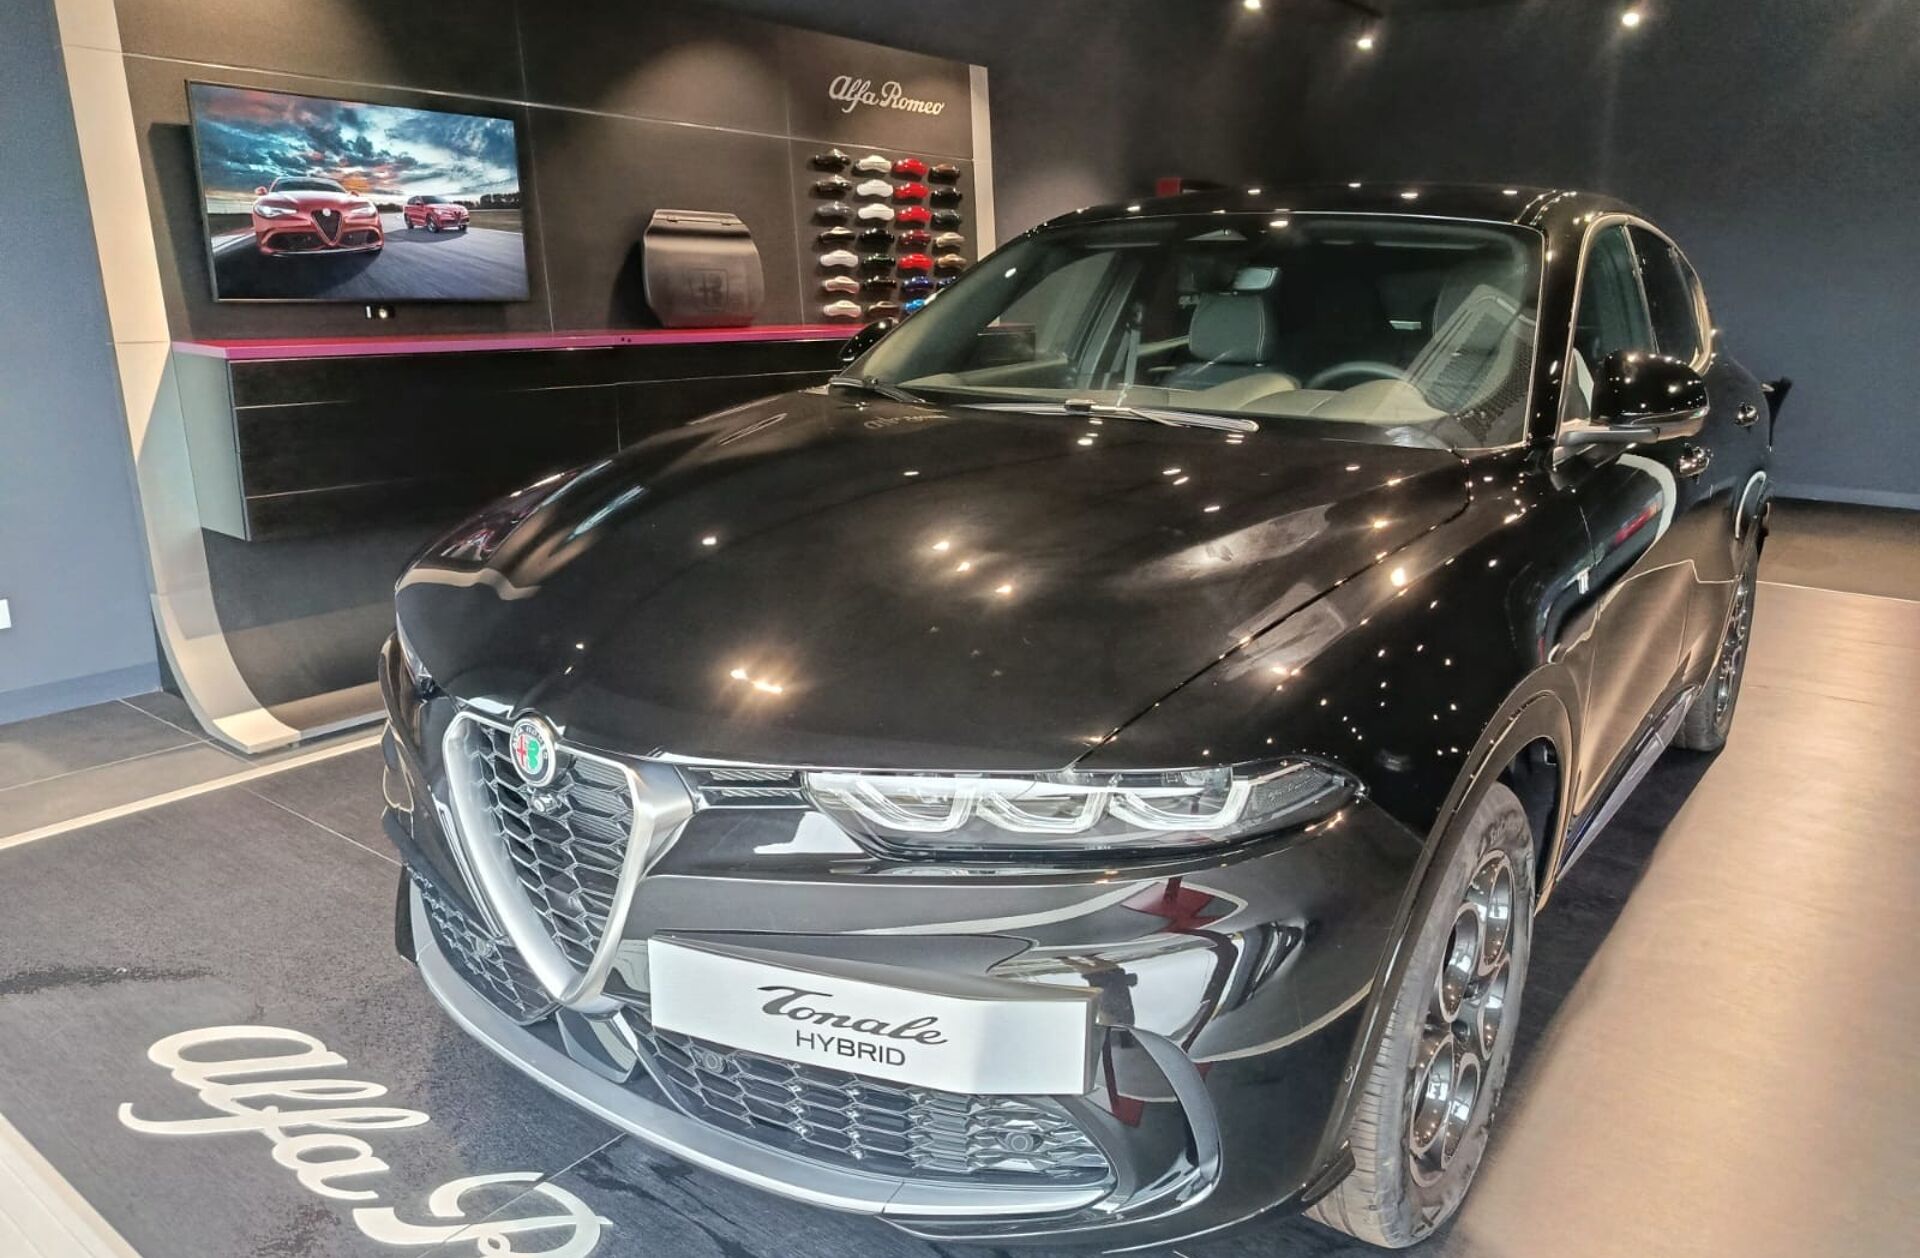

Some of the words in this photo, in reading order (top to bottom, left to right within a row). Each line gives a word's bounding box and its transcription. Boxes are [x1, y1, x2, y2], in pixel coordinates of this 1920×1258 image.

[828, 75, 879, 113] Alfa
[879, 81, 945, 115] Romeo
[757, 985, 949, 1045] Tonale
[796, 1029, 907, 1067] HYBRID
[117, 1024, 431, 1200] Alfa
